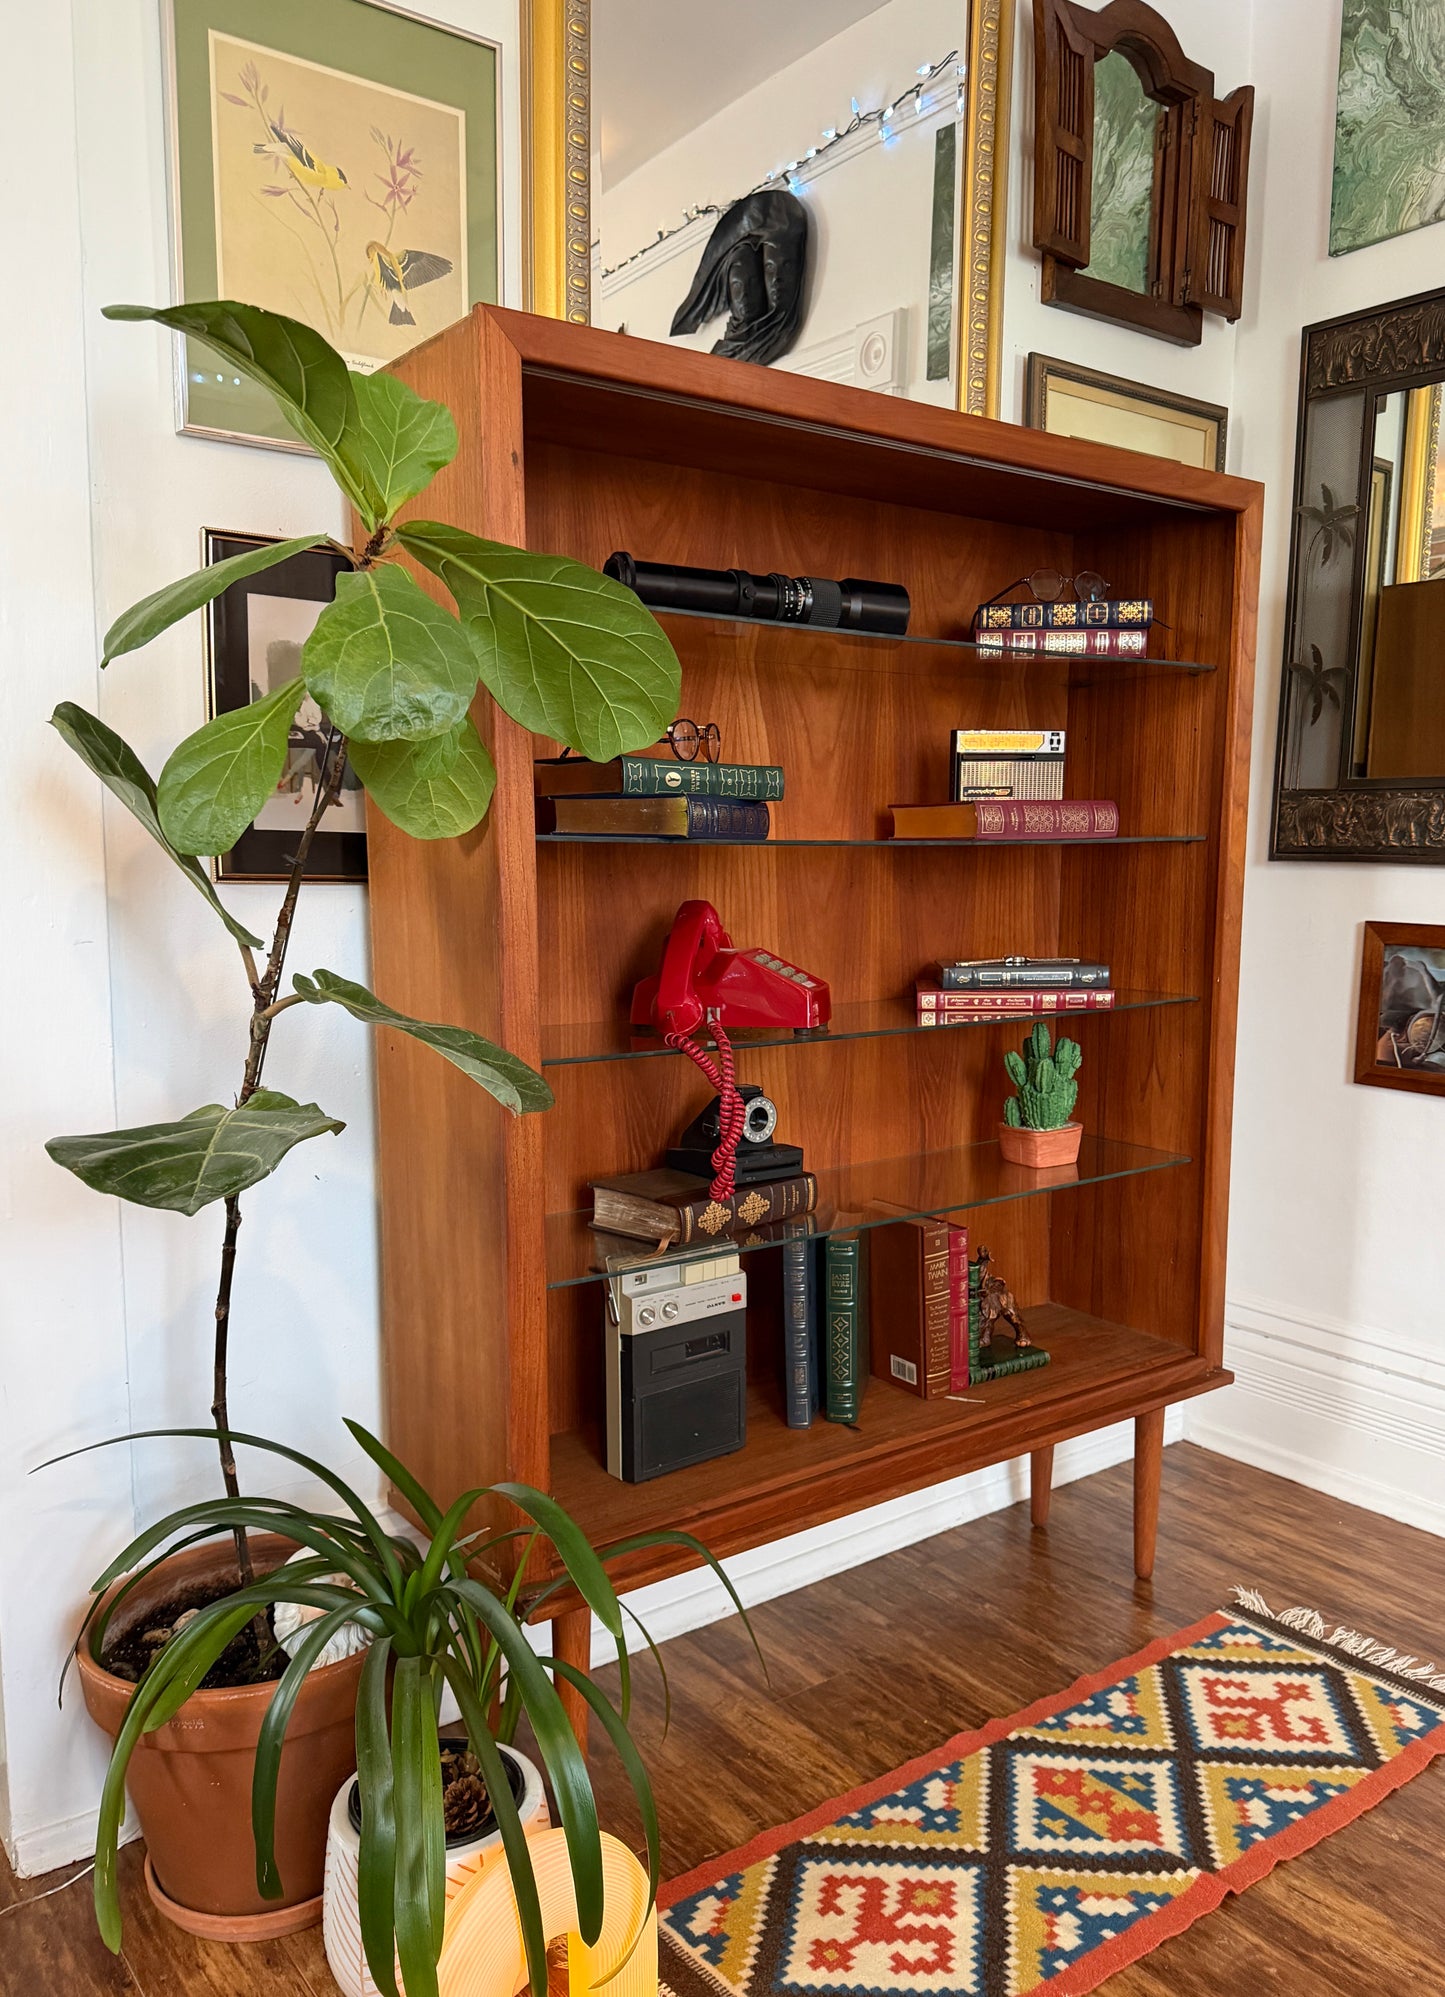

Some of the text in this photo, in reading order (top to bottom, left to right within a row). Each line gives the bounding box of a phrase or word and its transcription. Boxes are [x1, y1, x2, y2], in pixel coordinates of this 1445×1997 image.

[929, 1260, 946, 1271] MARK
[832, 1273, 850, 1281] JANE
[928, 1267, 948, 1280] TWAIN
